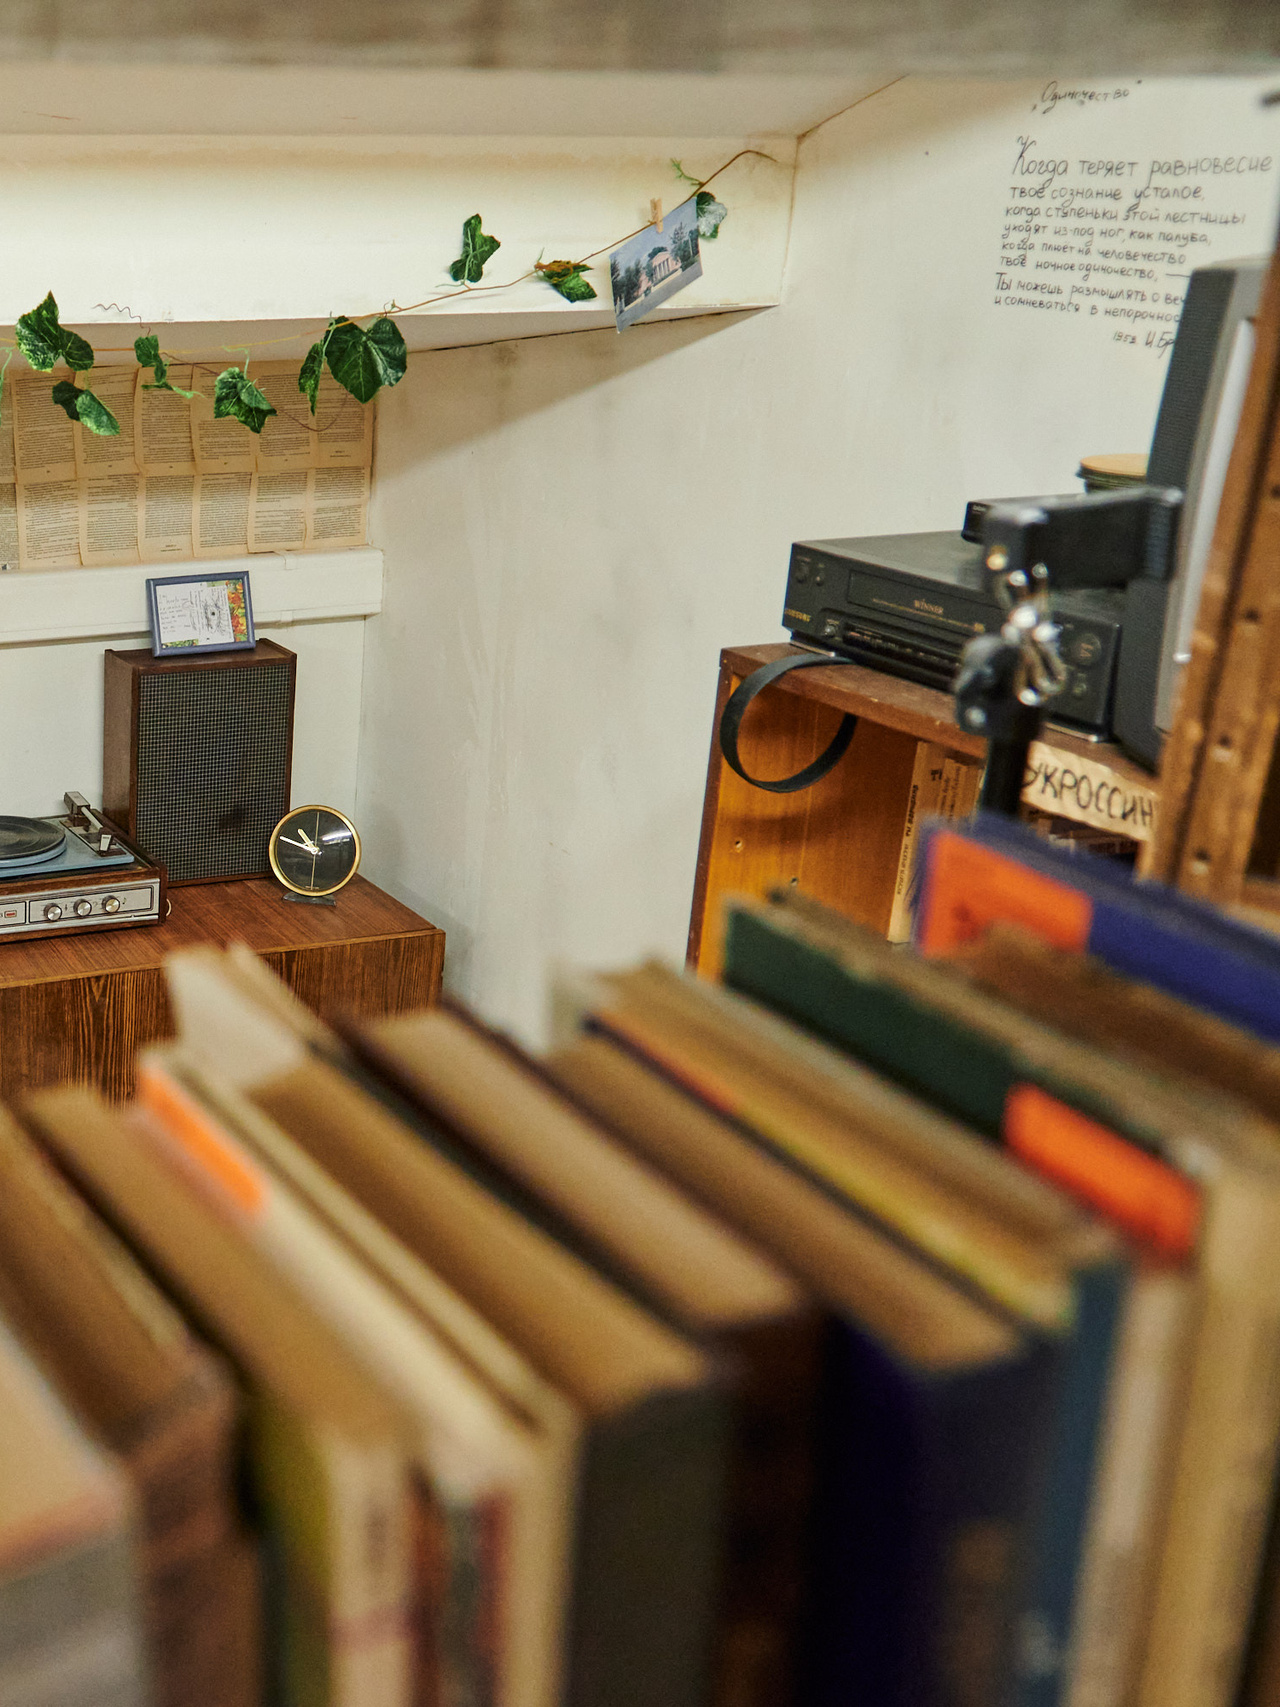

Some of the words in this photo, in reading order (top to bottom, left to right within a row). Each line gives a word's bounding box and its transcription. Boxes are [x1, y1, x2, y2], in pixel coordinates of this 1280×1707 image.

[1011, 135, 1070, 190] Когда
[1078, 159, 1139, 178] теряет
[1147, 155, 1273, 189] равновесие
[1051, 186, 1123, 209] сознание
[1005, 205, 1041, 224] когда
[1045, 206, 1119, 219] ступеньки
[1122, 207, 1160, 222] этой
[1164, 211, 1247, 225] лестницы
[1001, 222, 1049, 244] уходят
[1053, 226, 1095, 248] из-под
[1129, 229, 1155, 242] как
[1001, 241, 1036, 258] когда
[1078, 245, 1093, 257] на
[1097, 247, 1188, 265] человечество
[1034, 260, 1076, 273] ночное
[995, 272, 1013, 292] Ты
[1016, 280, 1064, 296] можешь
[1069, 284, 1149, 303] размышлять
[1151, 292, 1162, 303] о
[994, 295, 1003, 306] и
[1004, 295, 1081, 314] сомневаться
[1090, 304, 1100, 316] в
